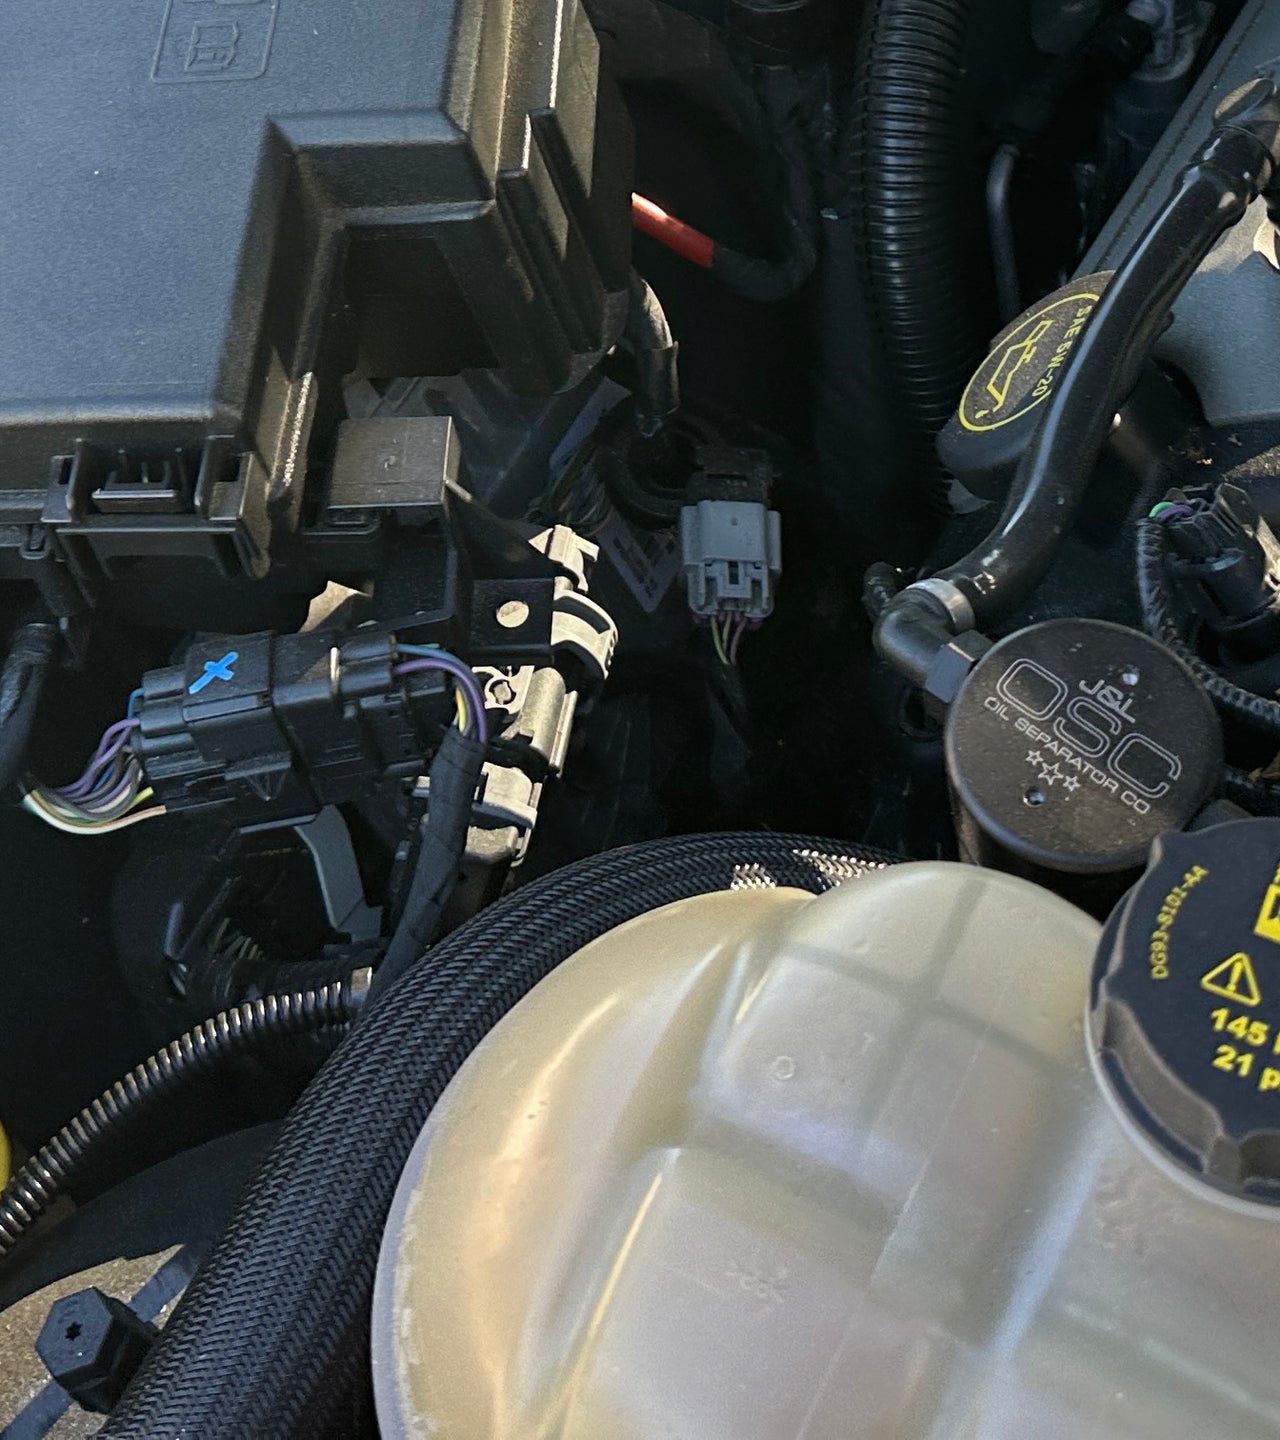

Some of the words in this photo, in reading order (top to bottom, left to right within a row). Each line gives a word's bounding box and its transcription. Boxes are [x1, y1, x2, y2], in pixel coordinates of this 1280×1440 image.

[1063, 305, 1093, 340] SAE
[1031, 340, 1073, 397] 5W-20
[1078, 679, 1136, 723] J&L
[996, 658, 1182, 798] OSC
[984, 696, 1010, 721] OIL
[1014, 717, 1119, 794] SEPARATOR
[1121, 790, 1151, 814] CO
[1212, 1007, 1269, 1046] 145
[1212, 1044, 1254, 1077] 21
